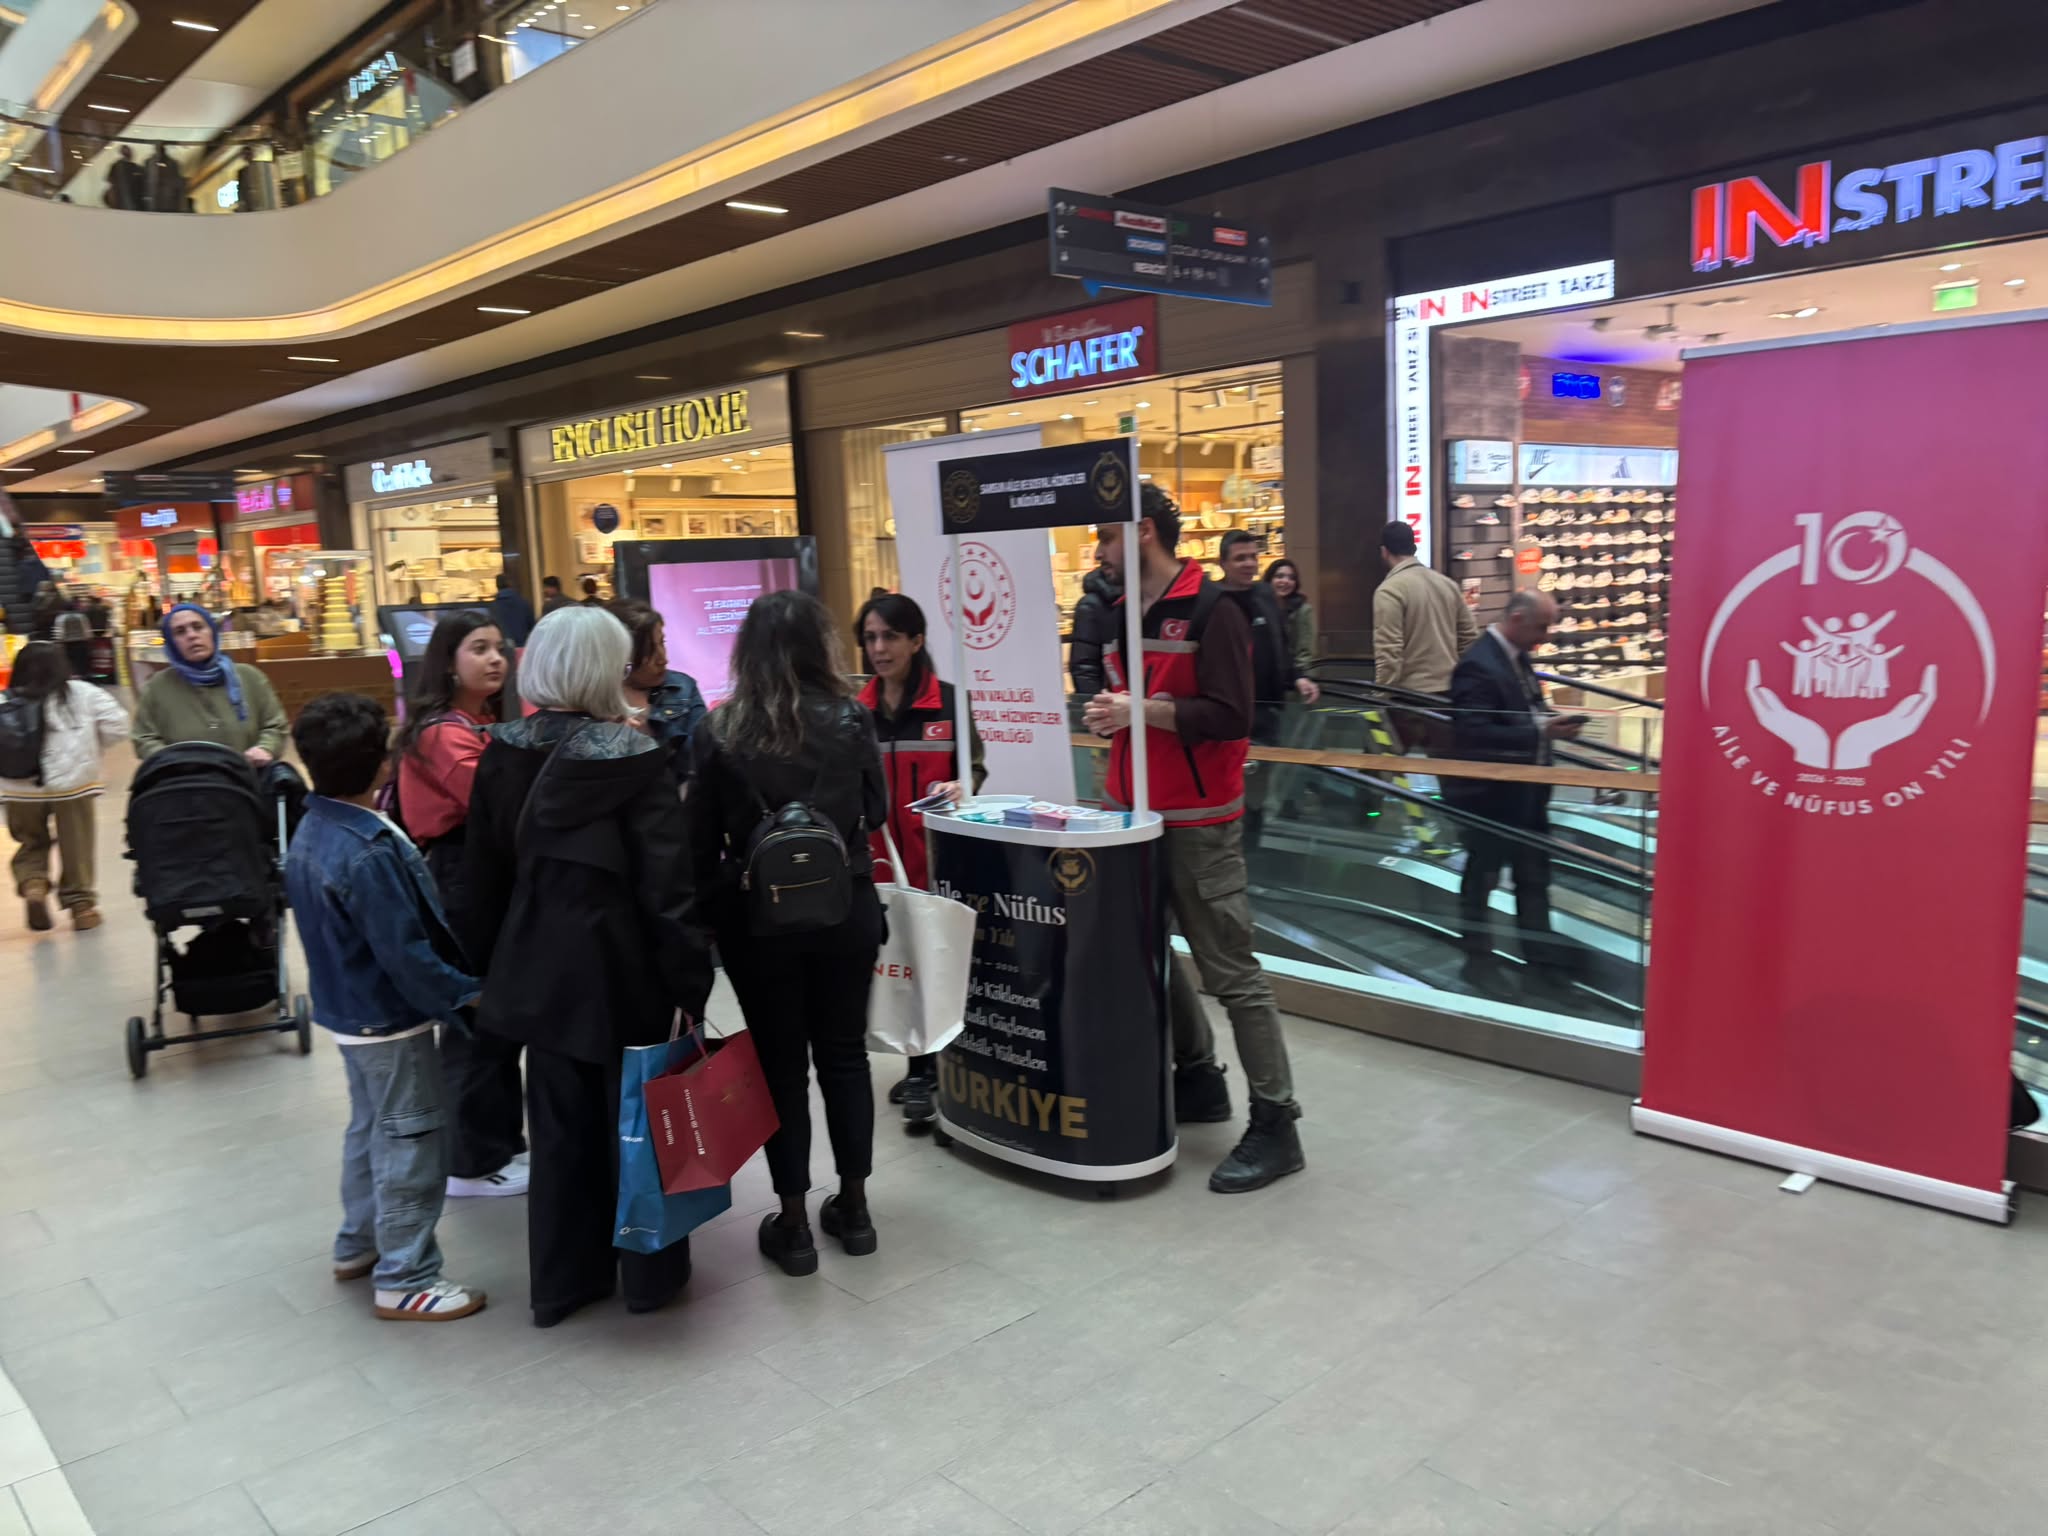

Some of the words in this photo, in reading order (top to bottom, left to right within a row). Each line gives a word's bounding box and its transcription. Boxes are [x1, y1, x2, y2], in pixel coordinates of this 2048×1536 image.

[1692, 135, 2048, 272] INSTRE
[1011, 330, 1140, 388] SCHAFER
[551, 408, 658, 463] ENGLISH
[660, 389, 752, 446] HOME
[1794, 510, 1909, 585] 10
[1751, 770, 1781, 796] VE
[1882, 781, 1926, 808] ON
[992, 892, 1067, 926] Nüfus
[874, 963, 912, 981] NER
[936, 1052, 1088, 1138] TÜRKİYE
